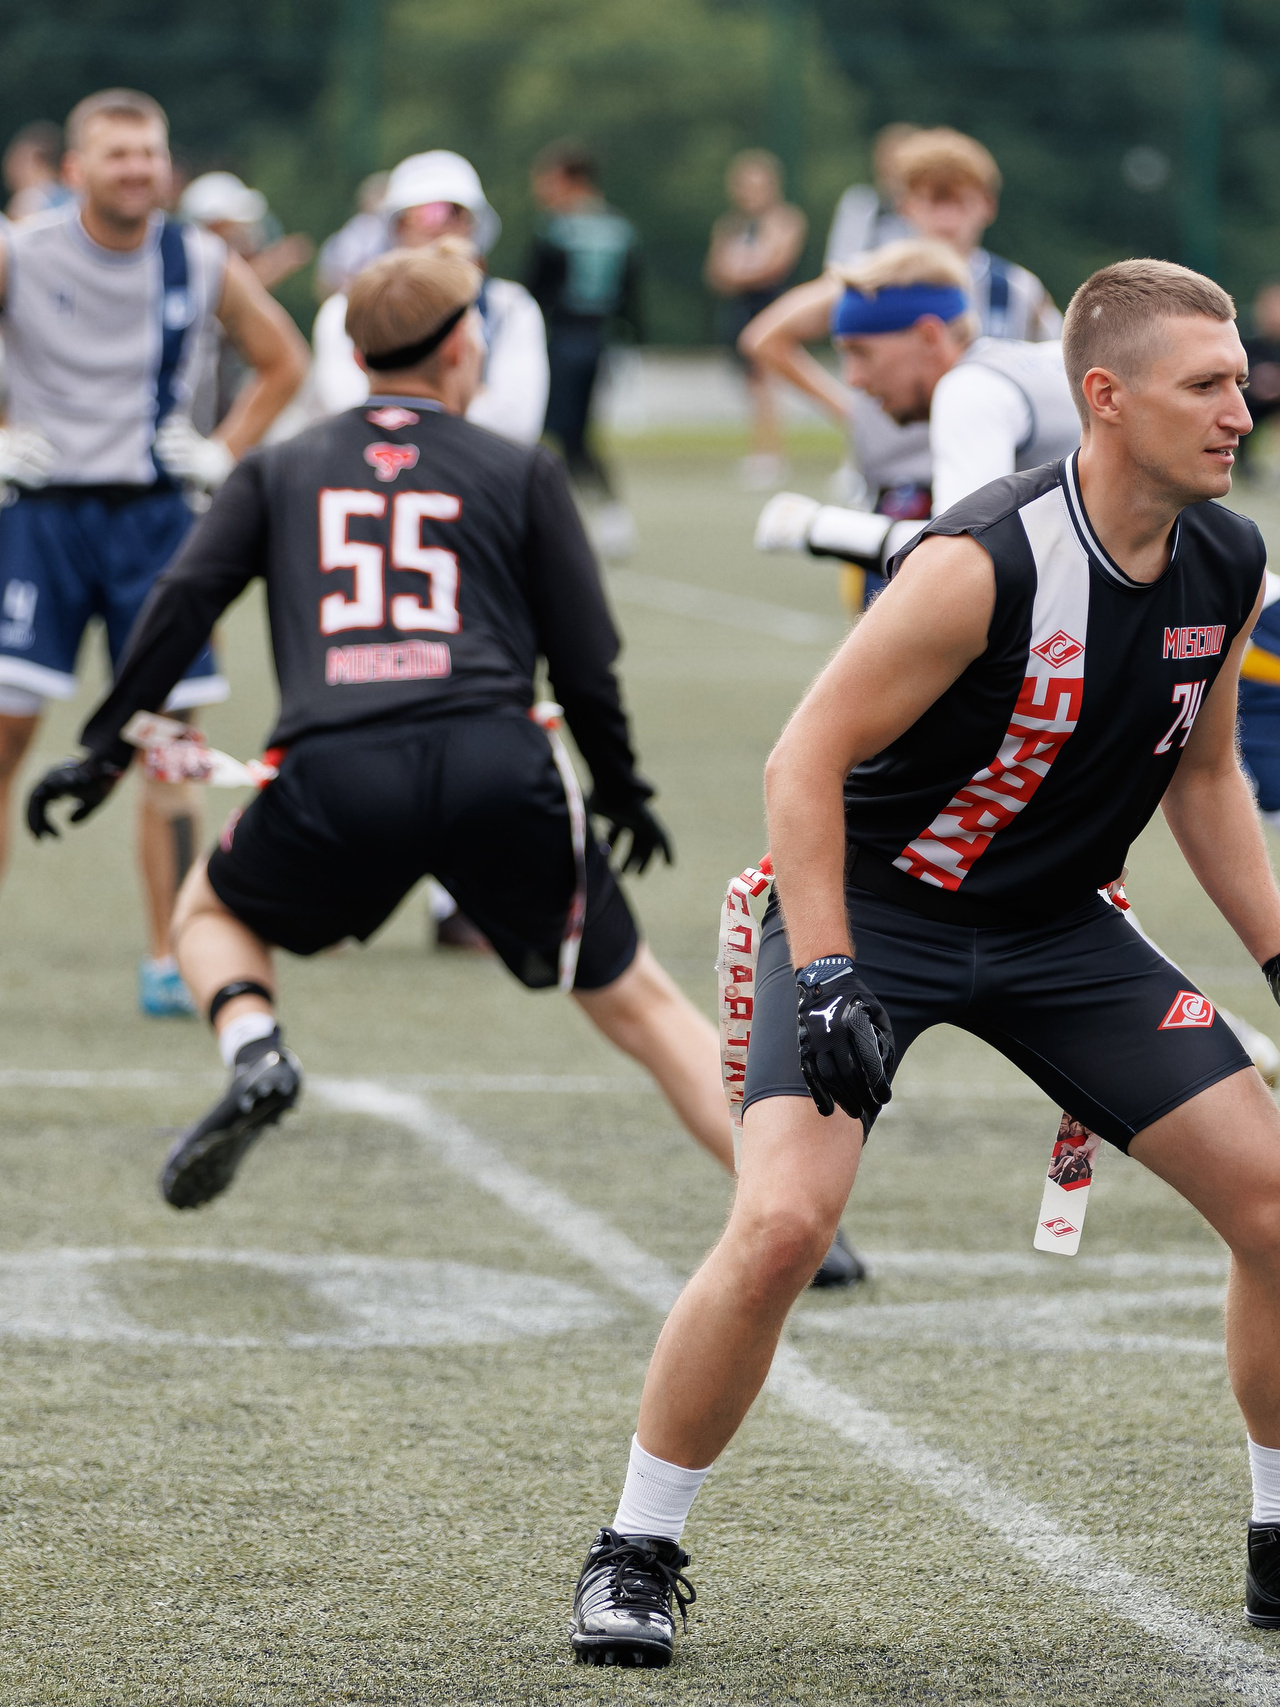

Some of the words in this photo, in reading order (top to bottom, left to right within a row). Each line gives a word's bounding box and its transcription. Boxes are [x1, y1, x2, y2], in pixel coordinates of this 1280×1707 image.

[318, 486, 462, 636] 55
[325, 640, 452, 686] MOSCOW
[1163, 625, 1226, 660] MOSCOW
[1153, 679, 1207, 755] 24
